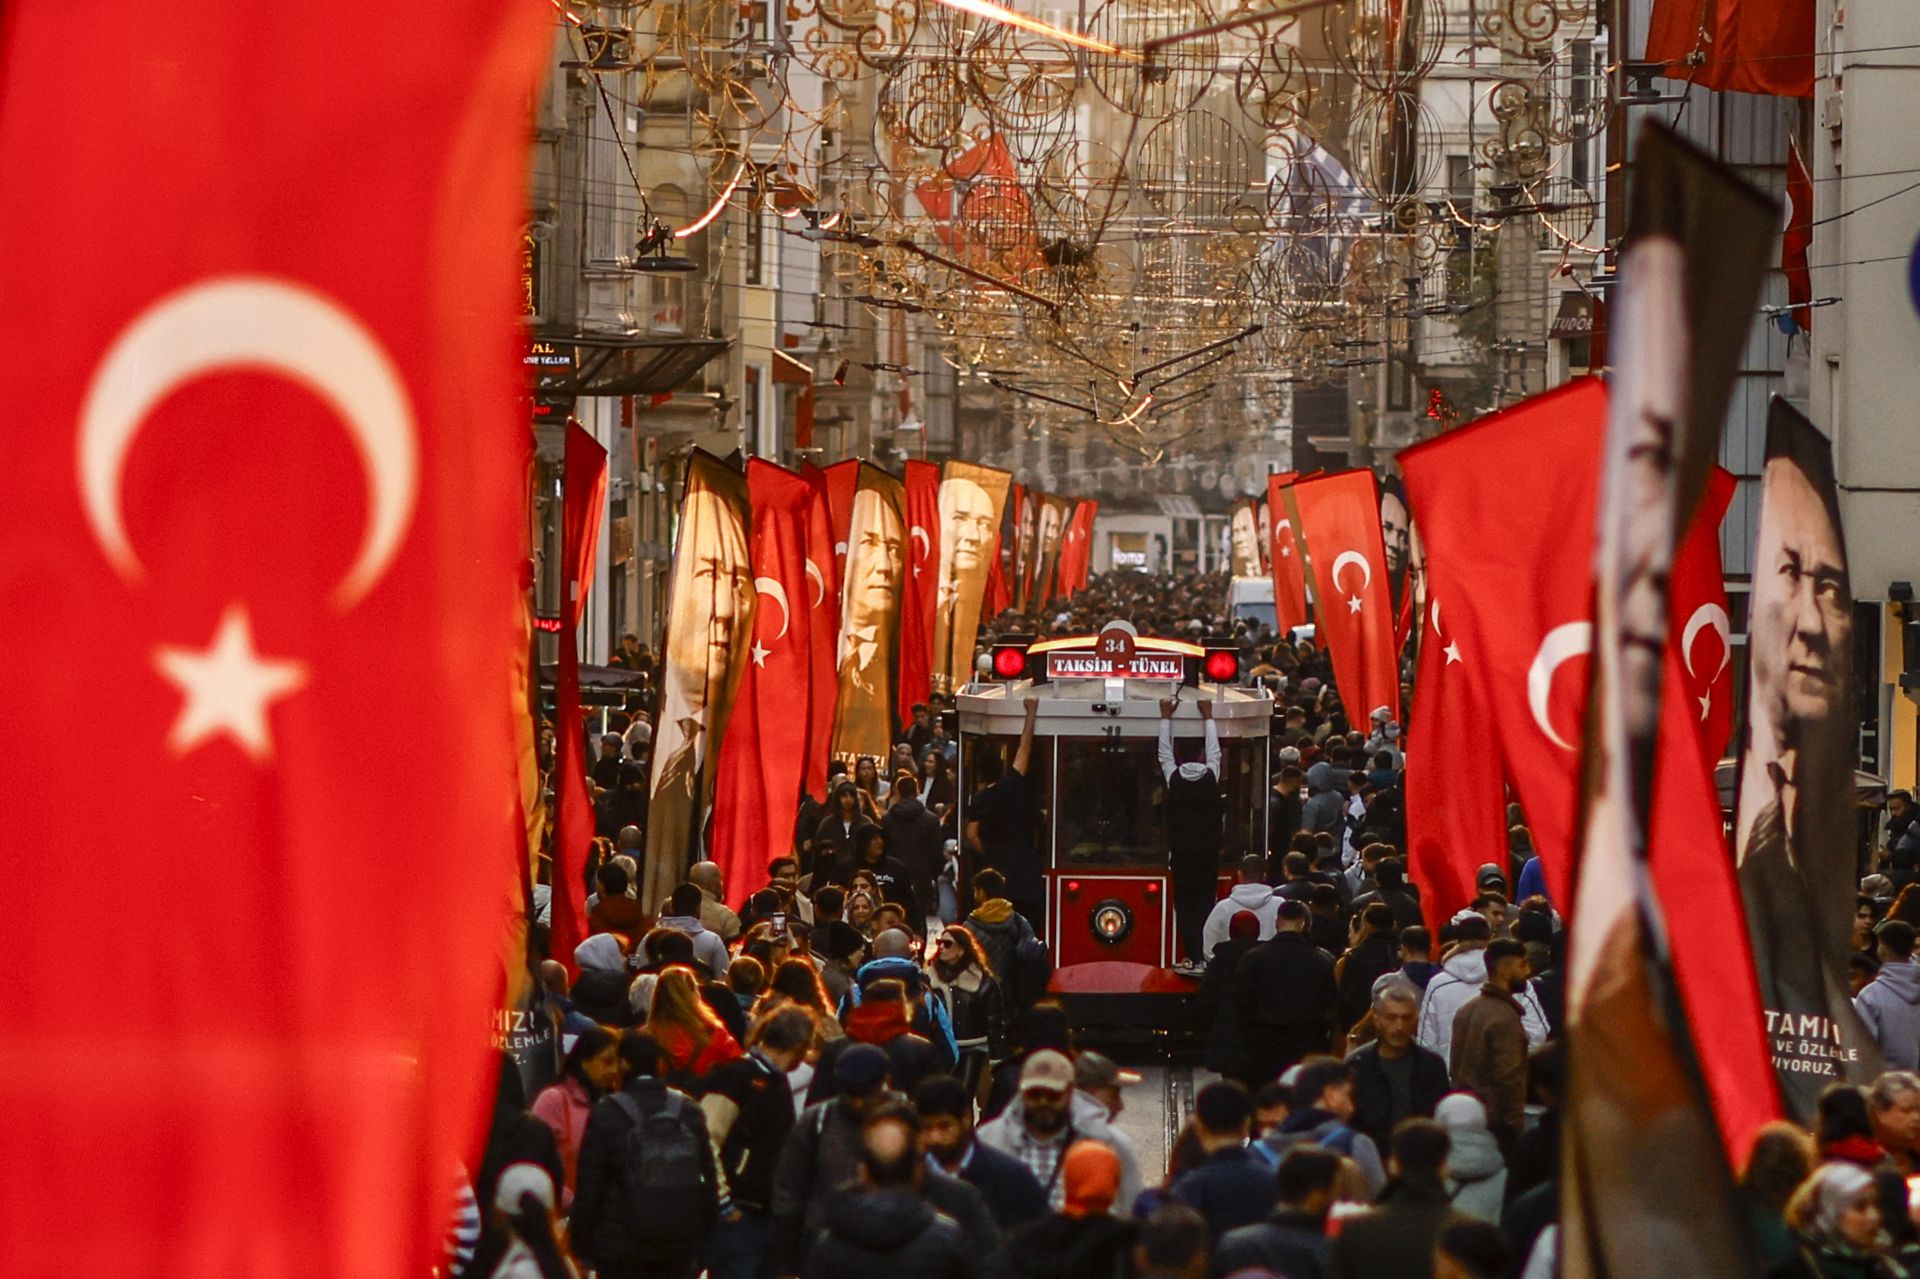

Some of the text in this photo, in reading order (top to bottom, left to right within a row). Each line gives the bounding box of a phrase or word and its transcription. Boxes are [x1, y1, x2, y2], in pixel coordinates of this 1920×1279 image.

[1554, 317, 1593, 330] TUDOR
[1105, 638, 1126, 653] 34
[1054, 656, 1114, 673] TAKSİM
[1128, 656, 1179, 674] TÜNEL
[1776, 1039, 1795, 1054] VE
[1771, 1055, 1837, 1077] IYORUZ.
